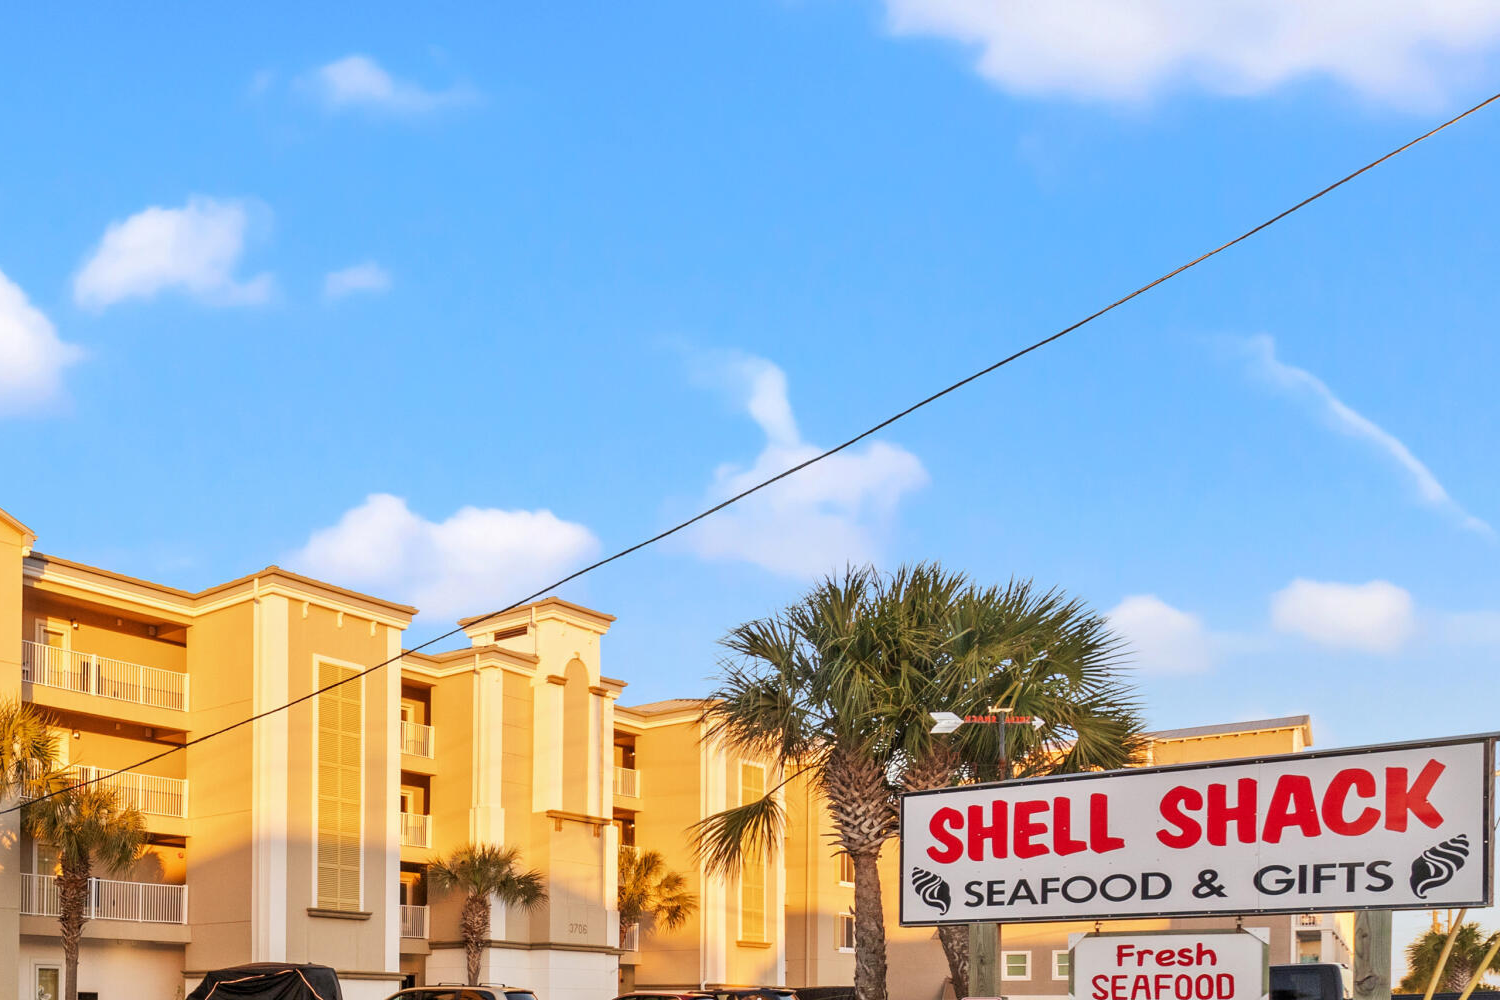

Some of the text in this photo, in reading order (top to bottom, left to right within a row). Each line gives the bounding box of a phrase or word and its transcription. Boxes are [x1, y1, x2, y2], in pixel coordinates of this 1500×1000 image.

[927, 758, 1446, 865] SHELL SHACK
[964, 860, 1394, 908] SEAFOOD & GIFTS
[1116, 942, 1218, 967] Fresh
[1091, 974, 1235, 1000] SEAFOOD
